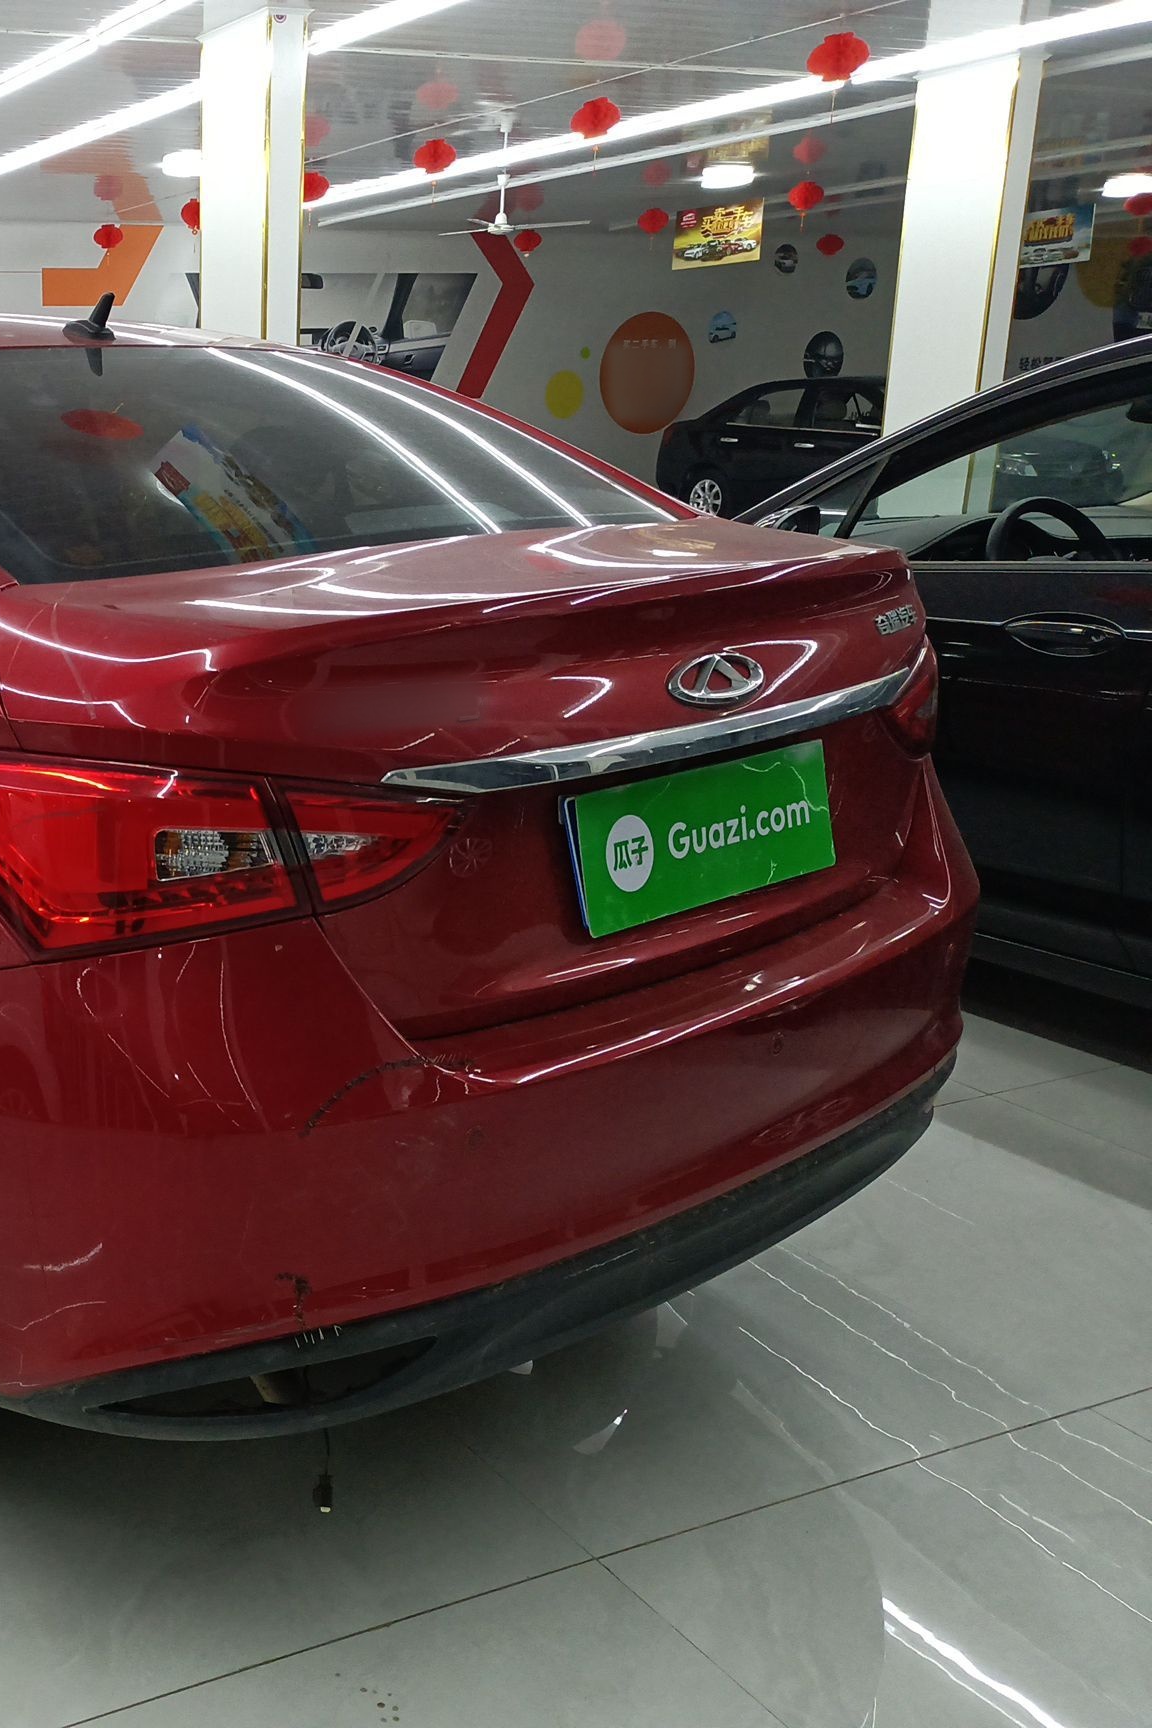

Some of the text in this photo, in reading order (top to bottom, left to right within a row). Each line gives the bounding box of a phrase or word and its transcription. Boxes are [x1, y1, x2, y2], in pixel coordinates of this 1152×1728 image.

[874, 604, 917, 635] 奇瑞汽车
[612, 799, 811, 871] 瓜子 Guazi.com
